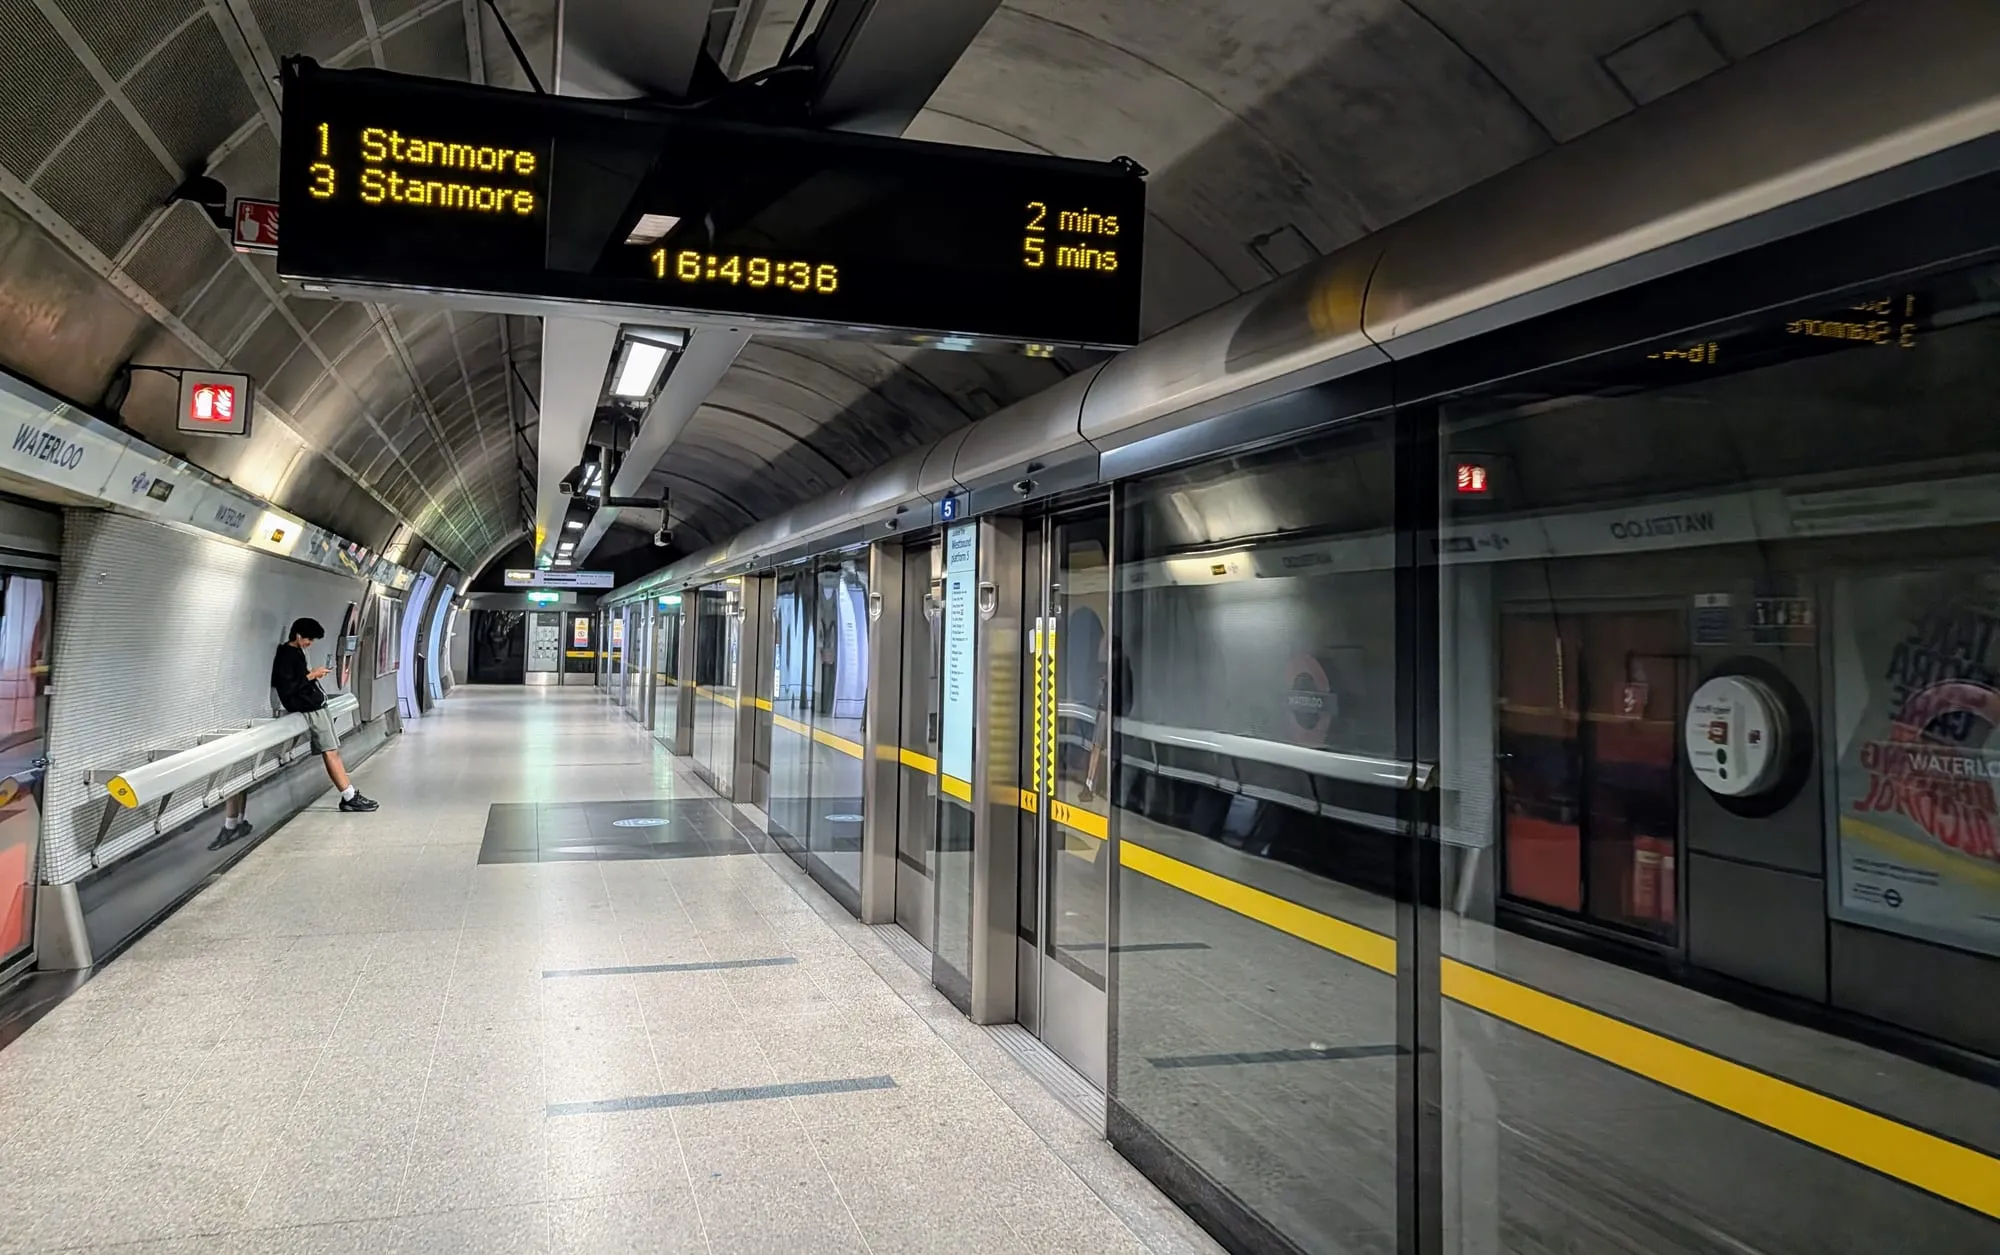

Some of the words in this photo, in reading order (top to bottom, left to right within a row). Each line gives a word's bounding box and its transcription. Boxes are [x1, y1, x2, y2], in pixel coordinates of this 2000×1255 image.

[317, 122, 330, 156] 1
[361, 127, 537, 175] Stanmore
[1025, 201, 1047, 232] 2
[1059, 207, 1120, 236] mins
[308, 162, 335, 198] 3
[360, 168, 535, 215] Stanmore
[1023, 237, 1045, 267] 5
[1056, 242, 1118, 271] mins
[650, 248, 839, 293] 16:49:36
[12, 422, 84, 470] WATERLOO
[943, 501, 952, 517] 5
